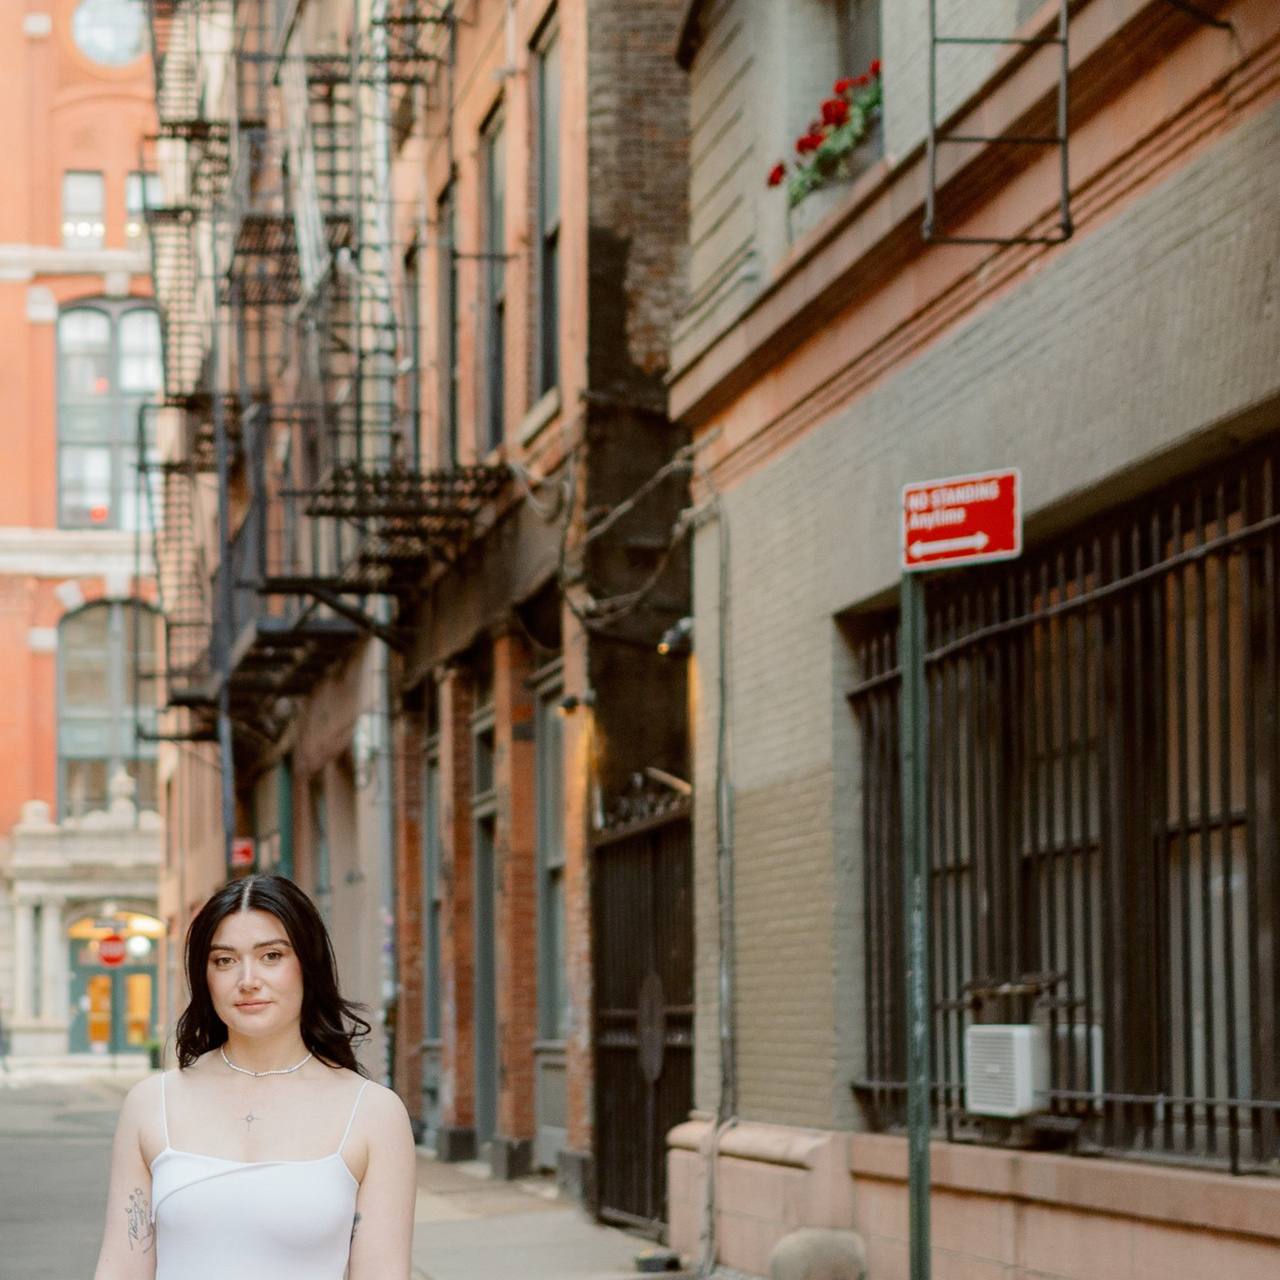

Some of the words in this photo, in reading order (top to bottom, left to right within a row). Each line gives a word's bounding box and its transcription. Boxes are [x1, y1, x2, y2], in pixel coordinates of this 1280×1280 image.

[909, 491, 928, 510] NO
[931, 480, 1000, 507] STANDING
[909, 508, 966, 530] Anytime
